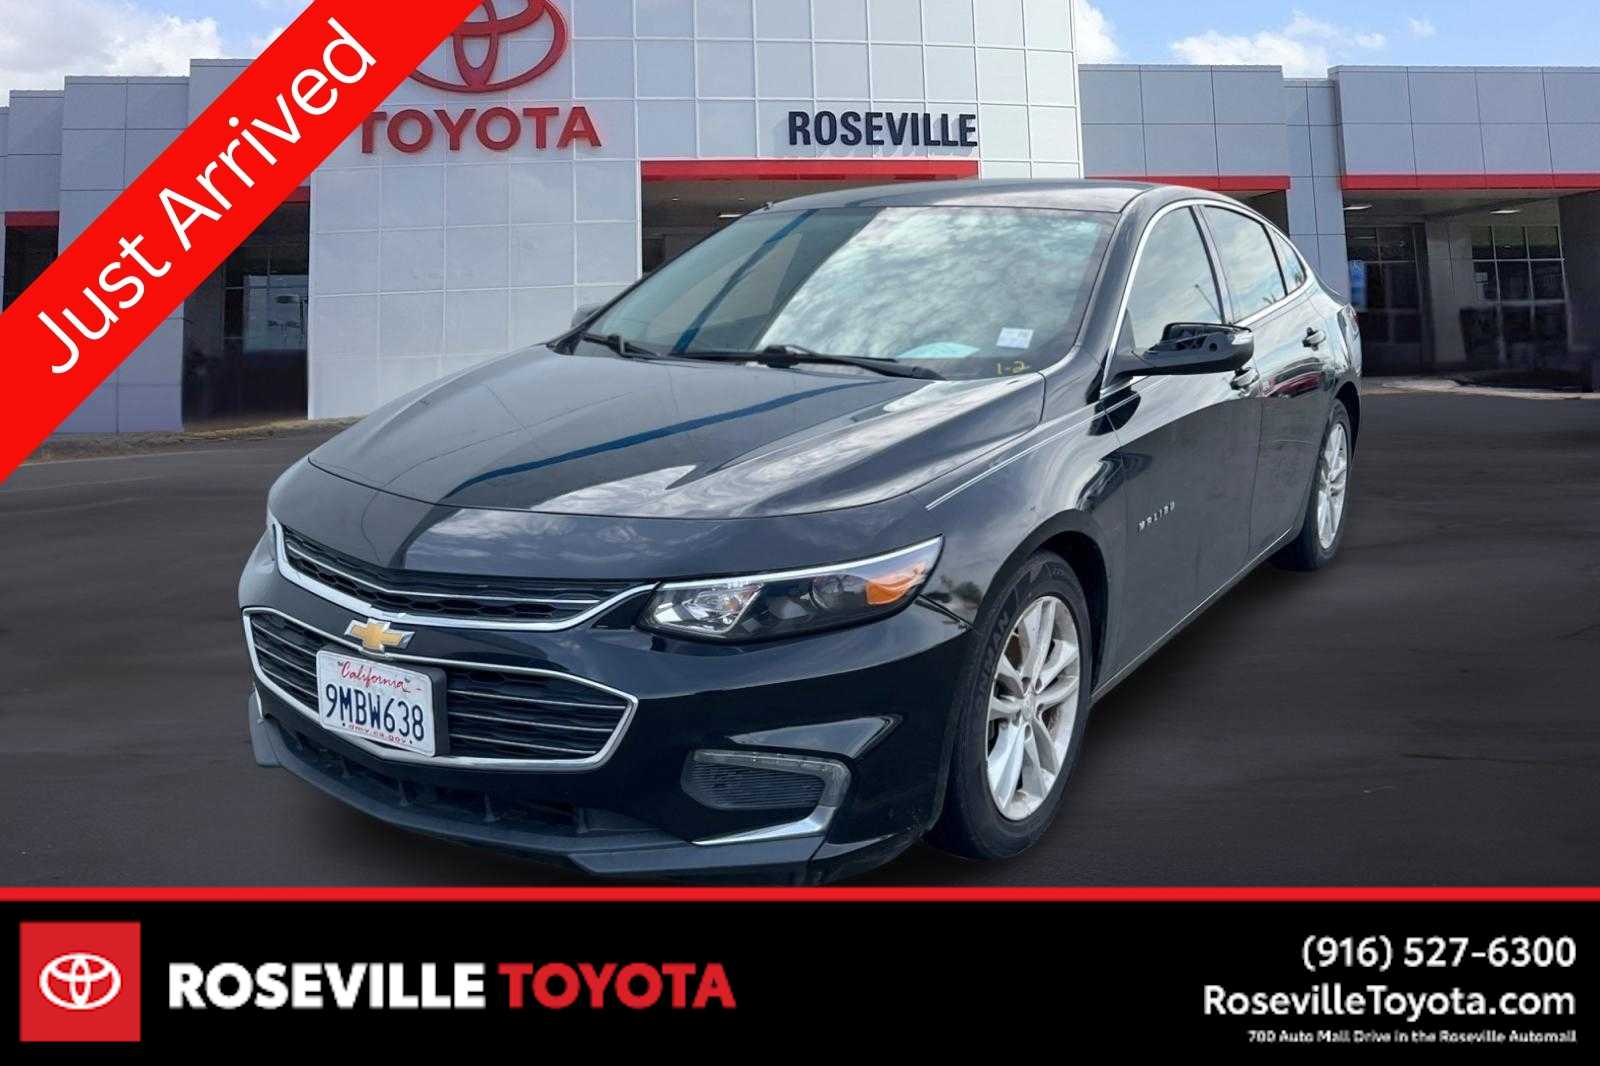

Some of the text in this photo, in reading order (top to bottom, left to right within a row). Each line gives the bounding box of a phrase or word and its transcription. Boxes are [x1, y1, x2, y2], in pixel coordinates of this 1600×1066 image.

[361, 106, 602, 153] TOYOTA
[788, 110, 978, 147] ROSEVILLE
[340, 659, 410, 693] California
[325, 683, 425, 742] 9MBW638
